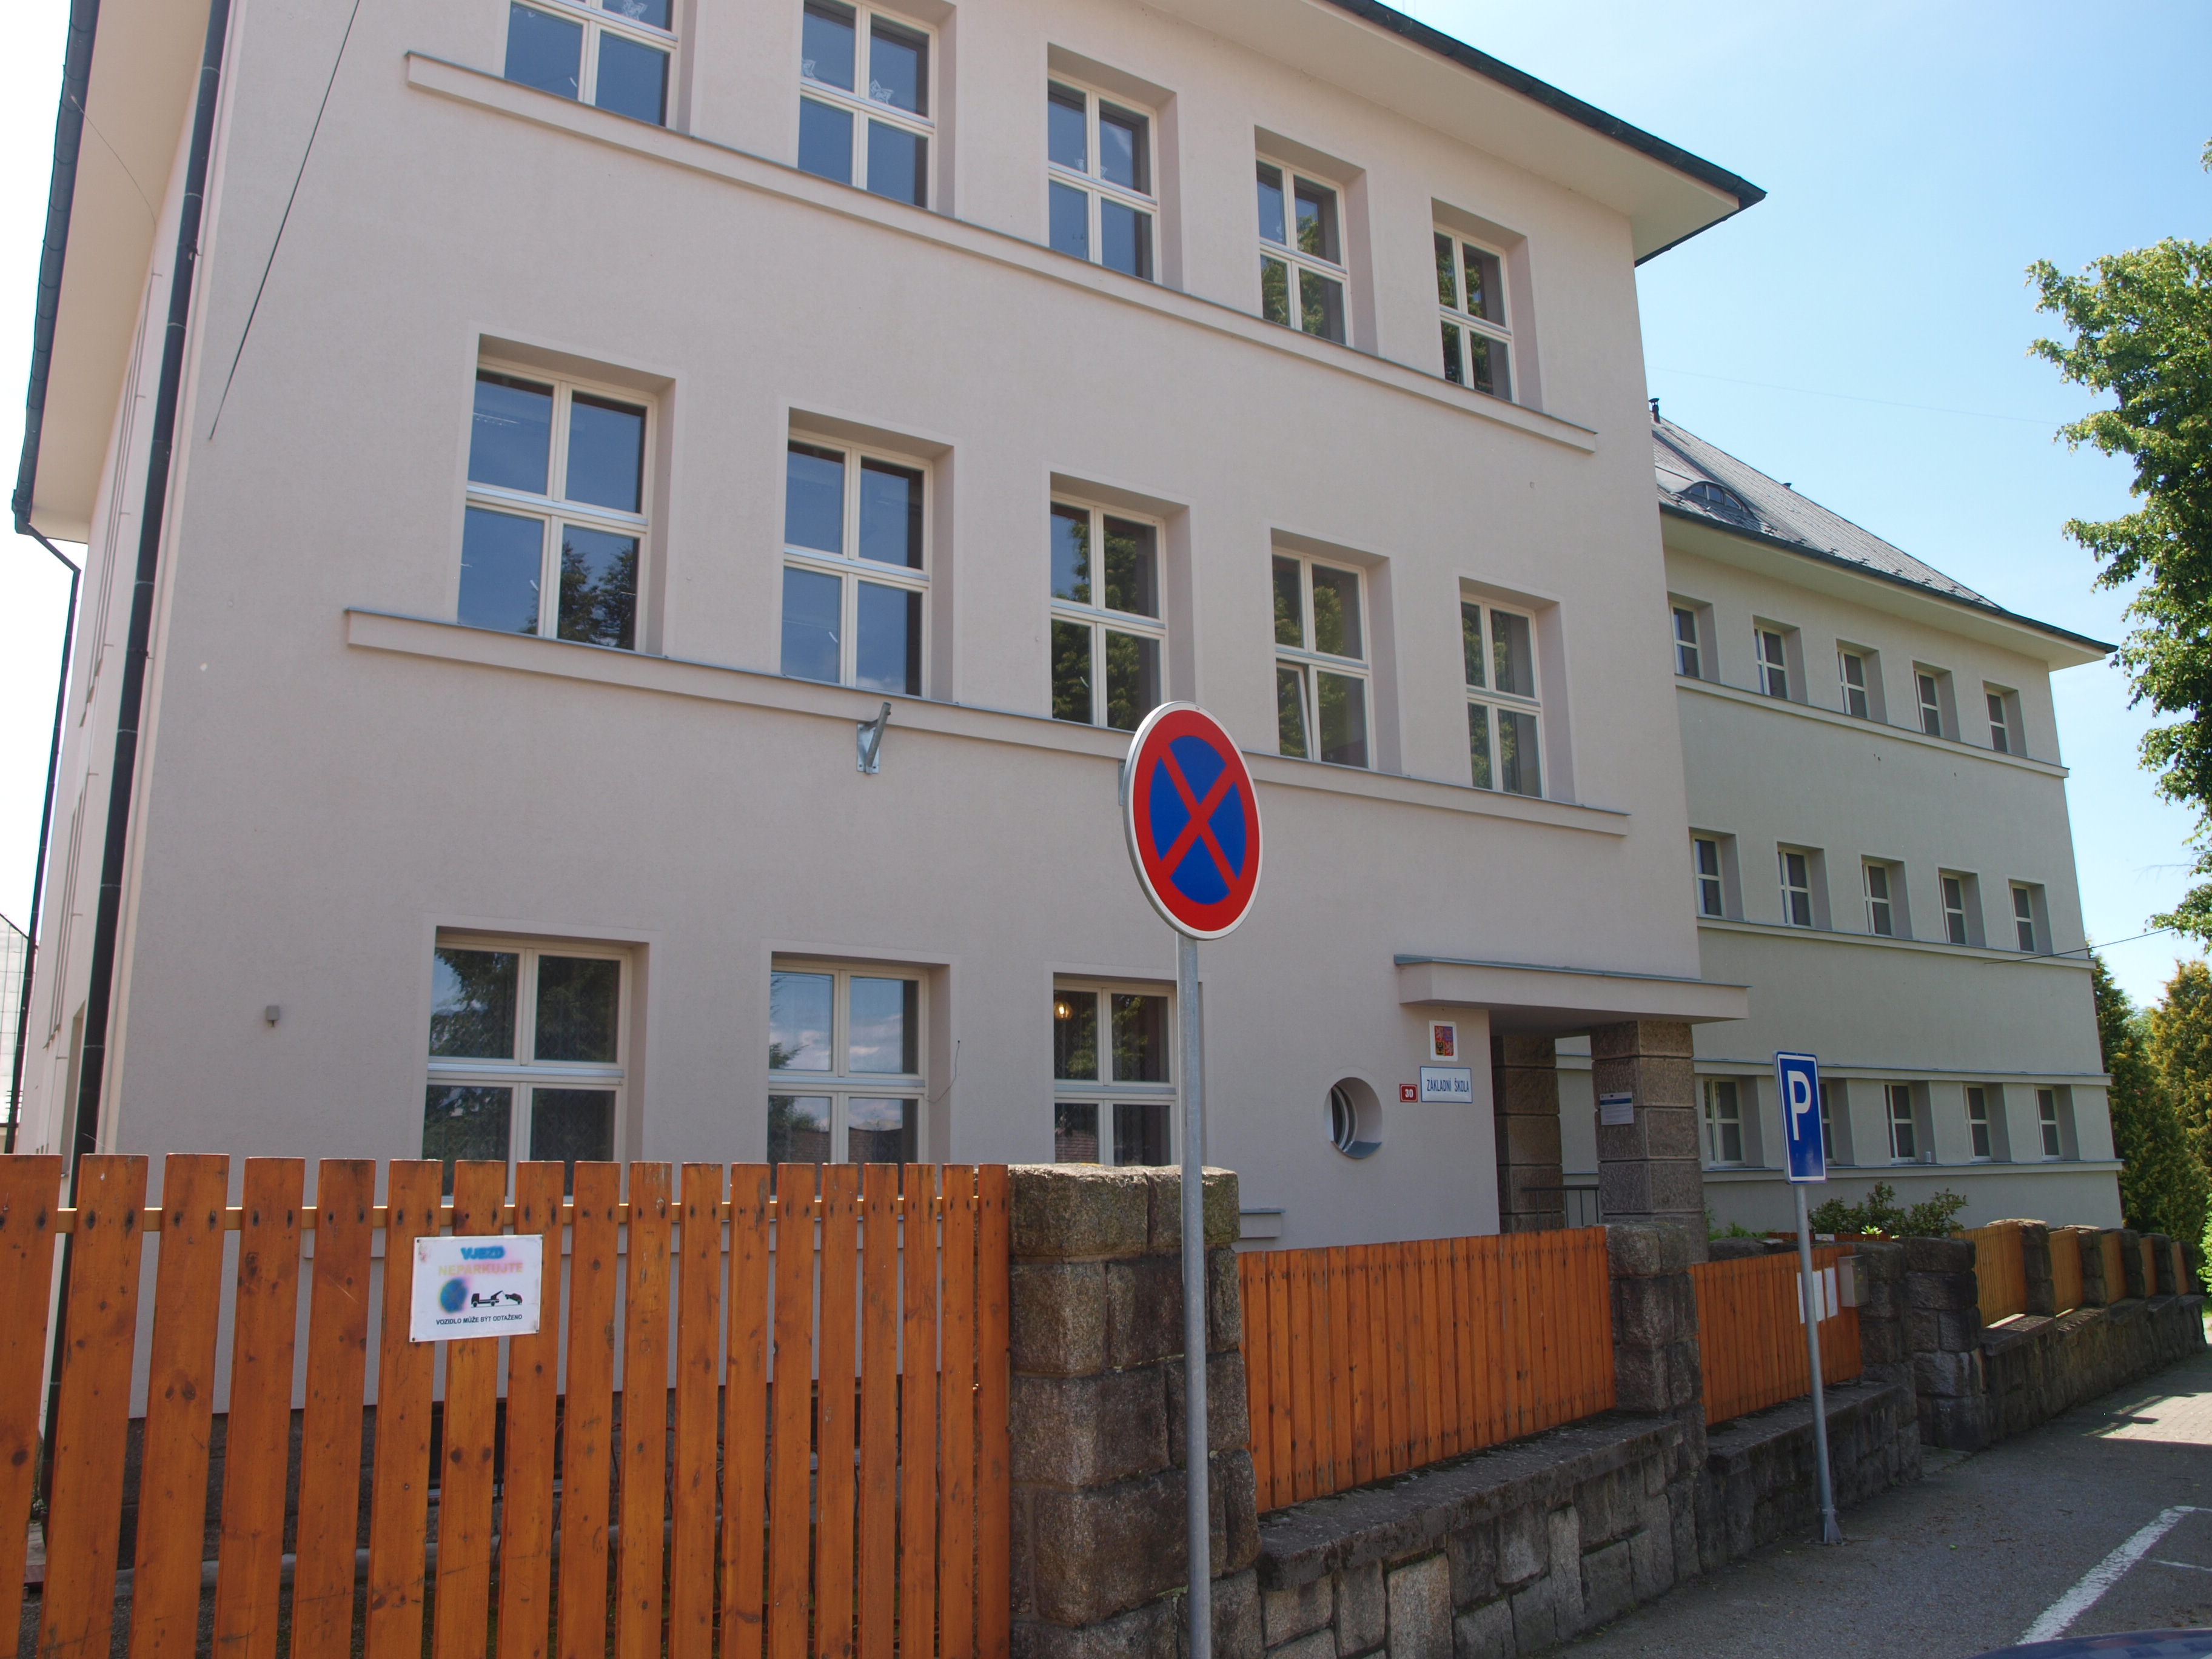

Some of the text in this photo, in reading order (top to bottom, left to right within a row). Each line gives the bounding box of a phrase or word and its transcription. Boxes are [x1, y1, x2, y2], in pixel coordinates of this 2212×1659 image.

[1427, 1078, 1470, 1092] ZÁKLADNÍ ŠKOLA
[1405, 1088, 1413, 1098] 30
[1787, 1070, 1811, 1141] P
[460, 1245, 505, 1260] VJEZD
[438, 1262, 523, 1276] NEPARKUJTE
